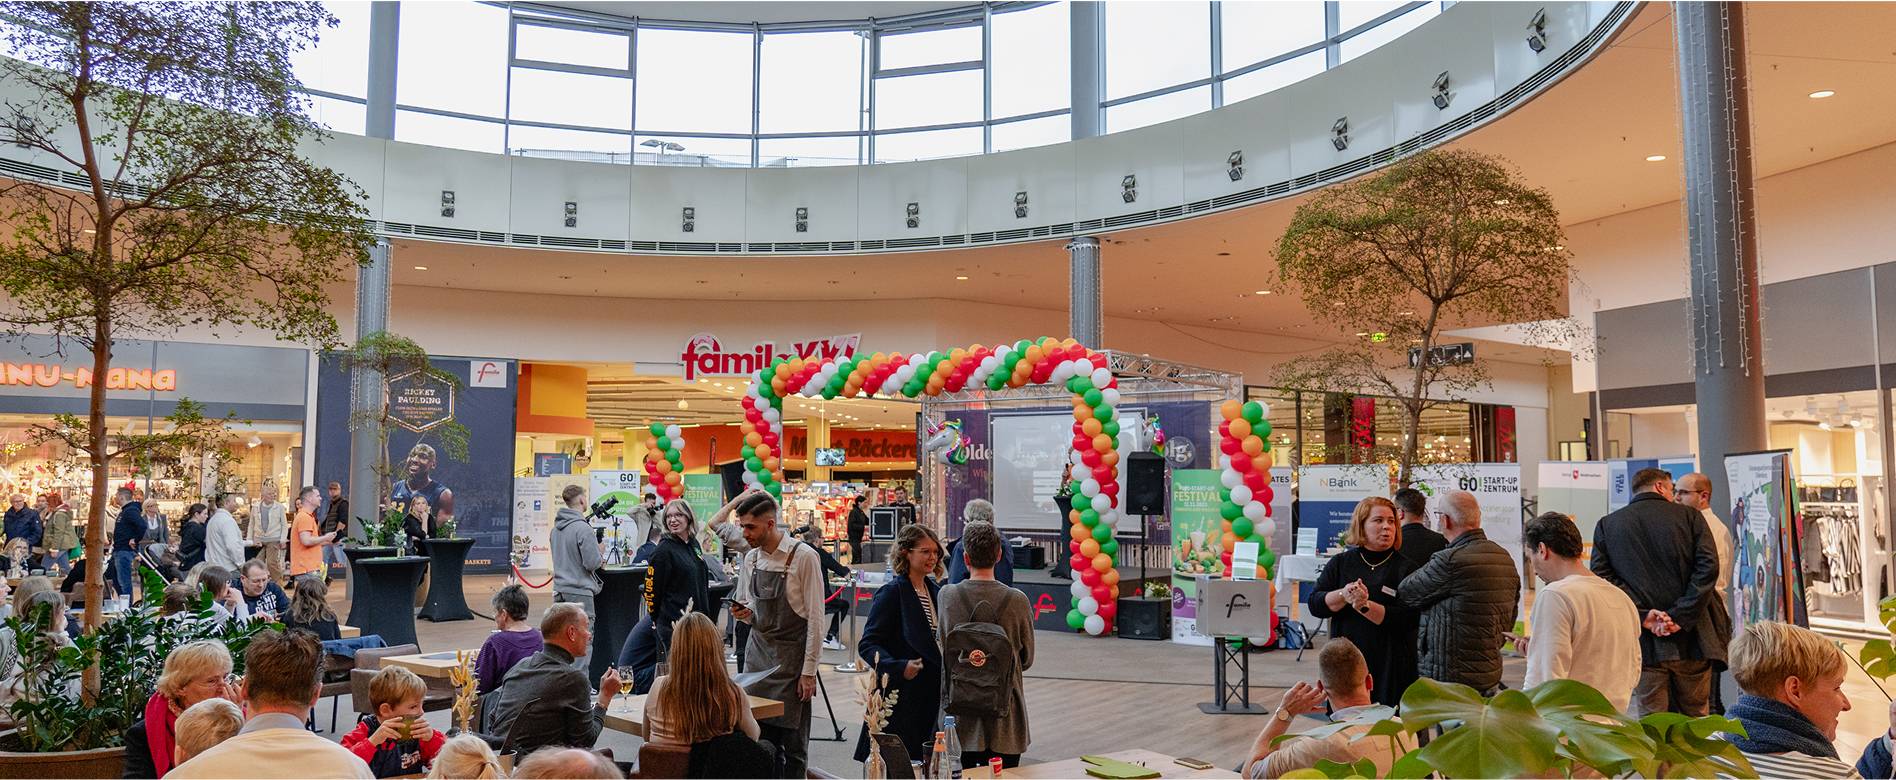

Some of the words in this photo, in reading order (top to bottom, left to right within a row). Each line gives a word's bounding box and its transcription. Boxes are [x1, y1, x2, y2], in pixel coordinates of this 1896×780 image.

[682, 334, 793, 380] famil
[404, 388, 436, 396] RICKEY
[398, 396, 441, 404] PAULDING
[1319, 478, 1357, 487] NBank
[1483, 476, 1518, 485] START-UP
[1483, 485, 1519, 493] ZENTRUM
